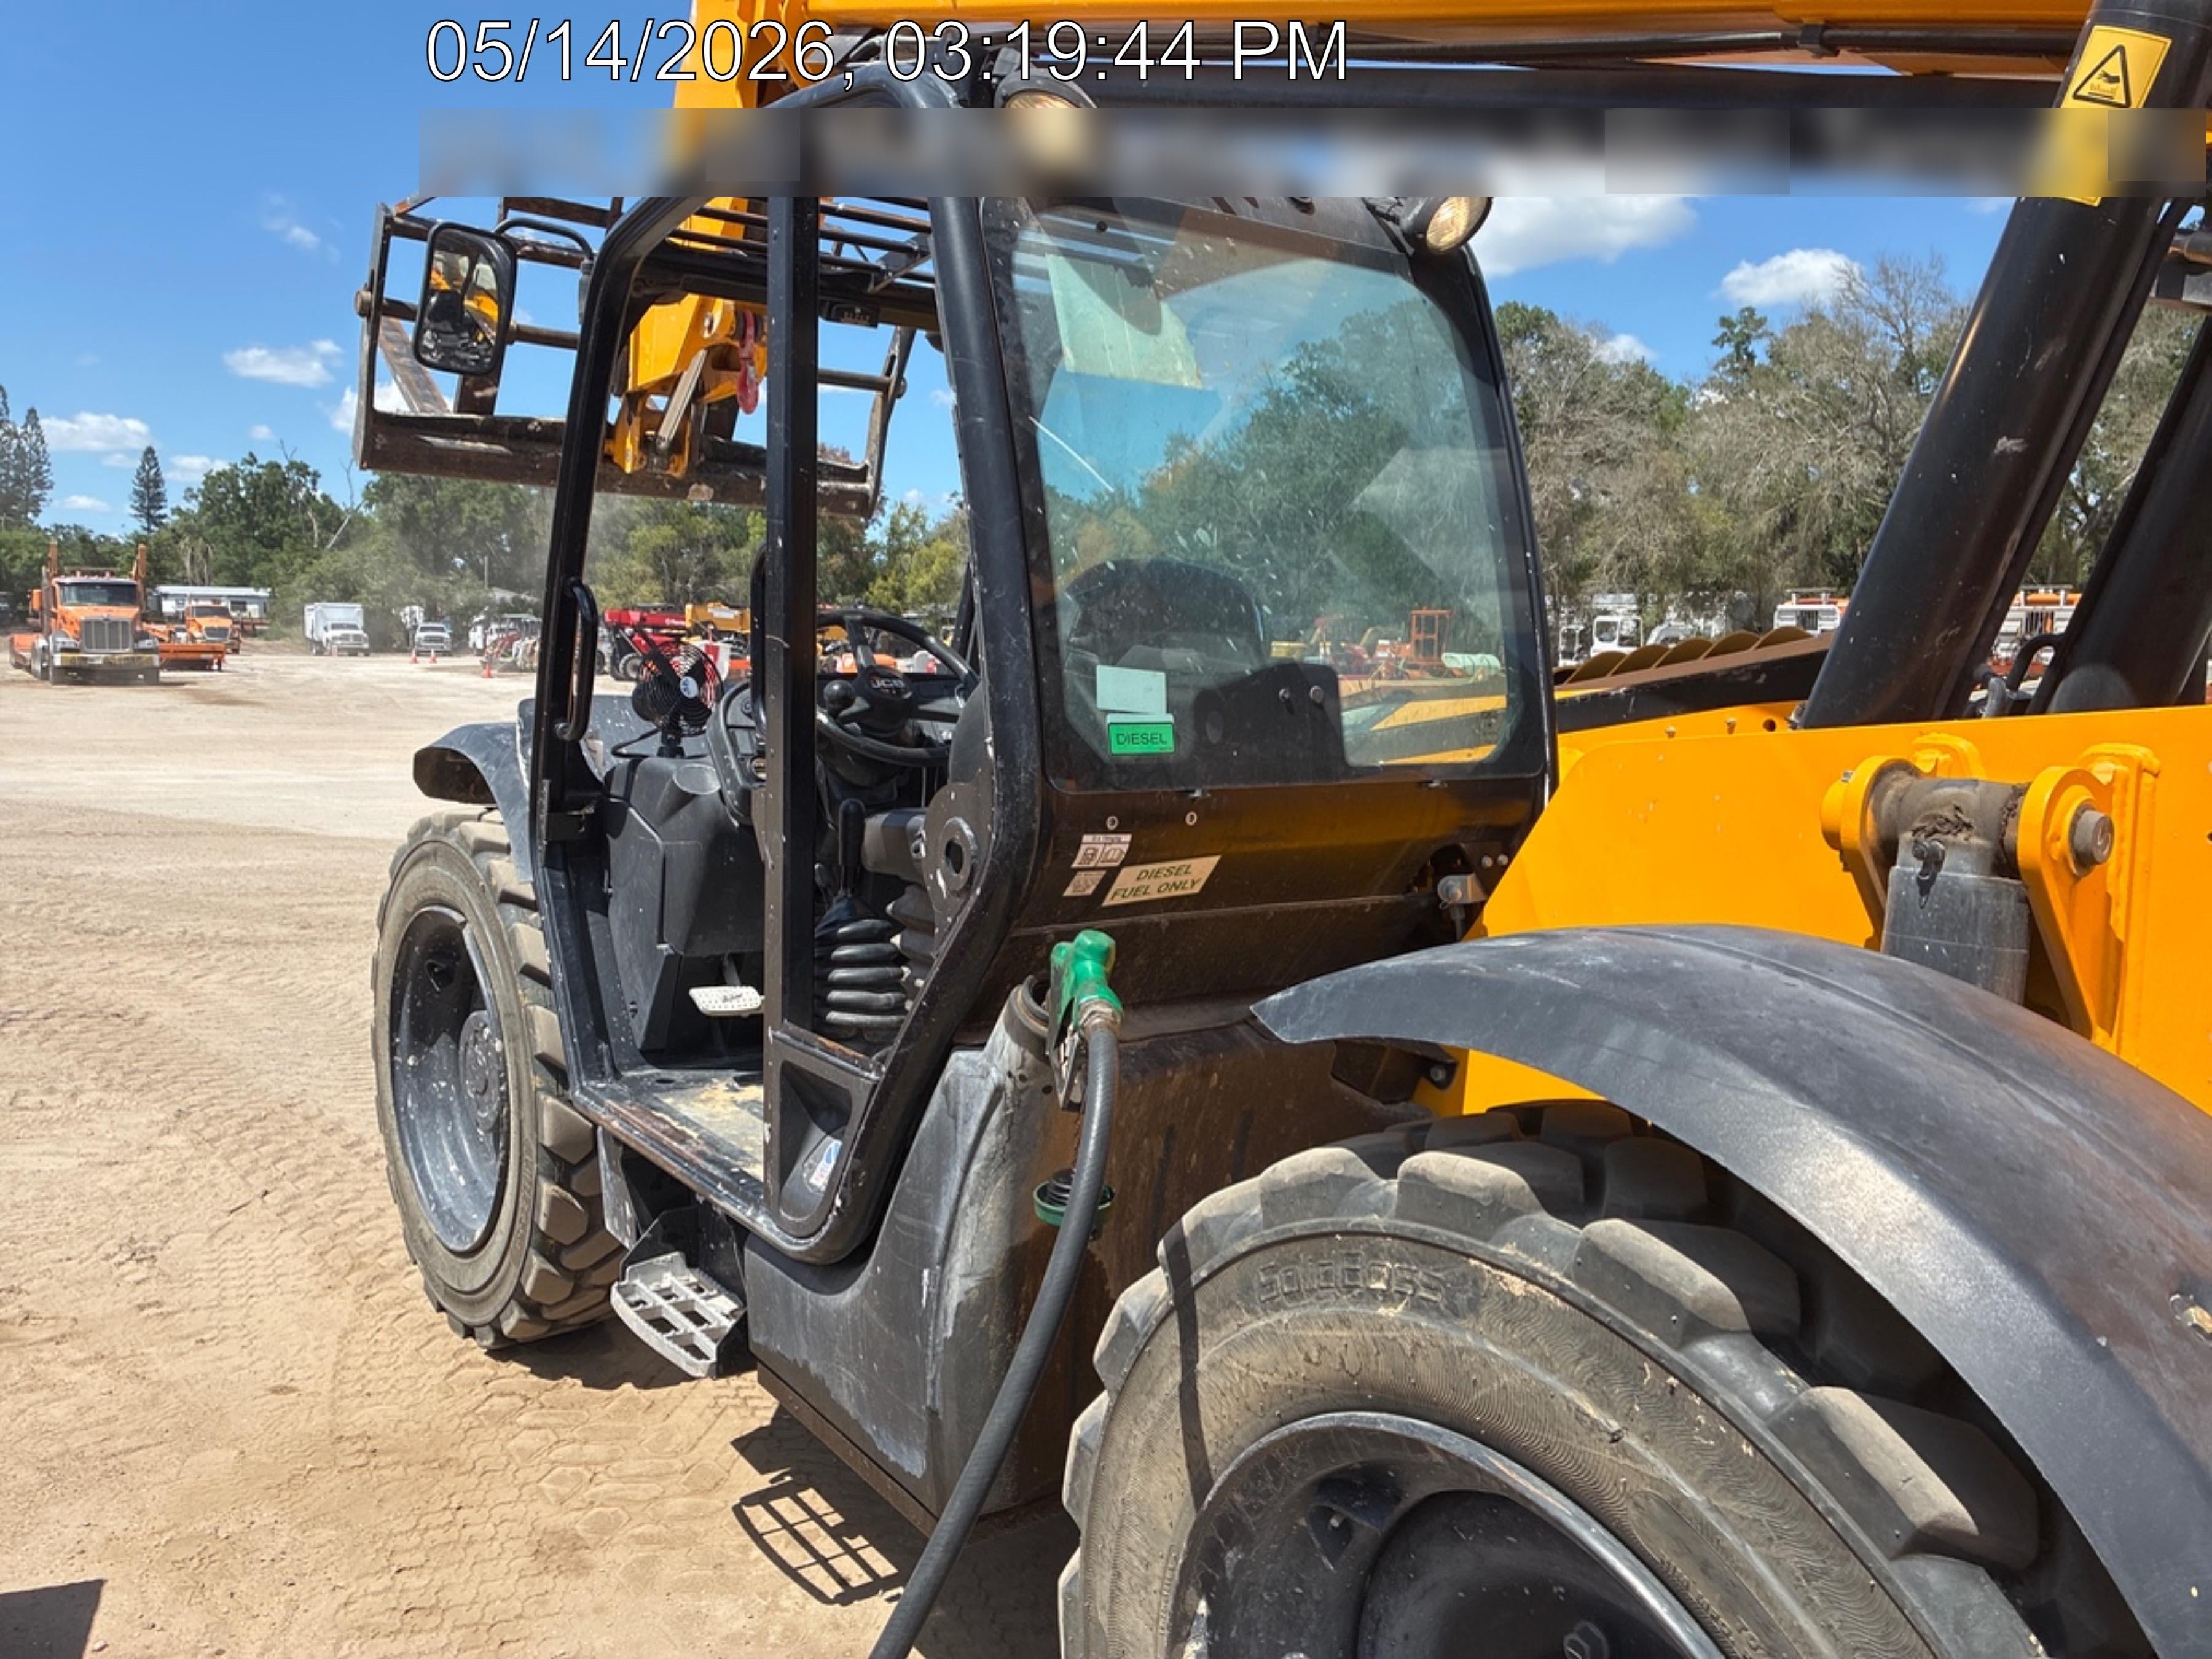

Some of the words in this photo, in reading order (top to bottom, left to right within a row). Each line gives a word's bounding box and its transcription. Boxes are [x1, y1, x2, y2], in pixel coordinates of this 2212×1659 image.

[1116, 732, 1167, 745] DIESEL
[1136, 864, 1192, 881] DIESEL
[1111, 885, 1151, 900] FUEL
[1157, 877, 1201, 893] ONLY
